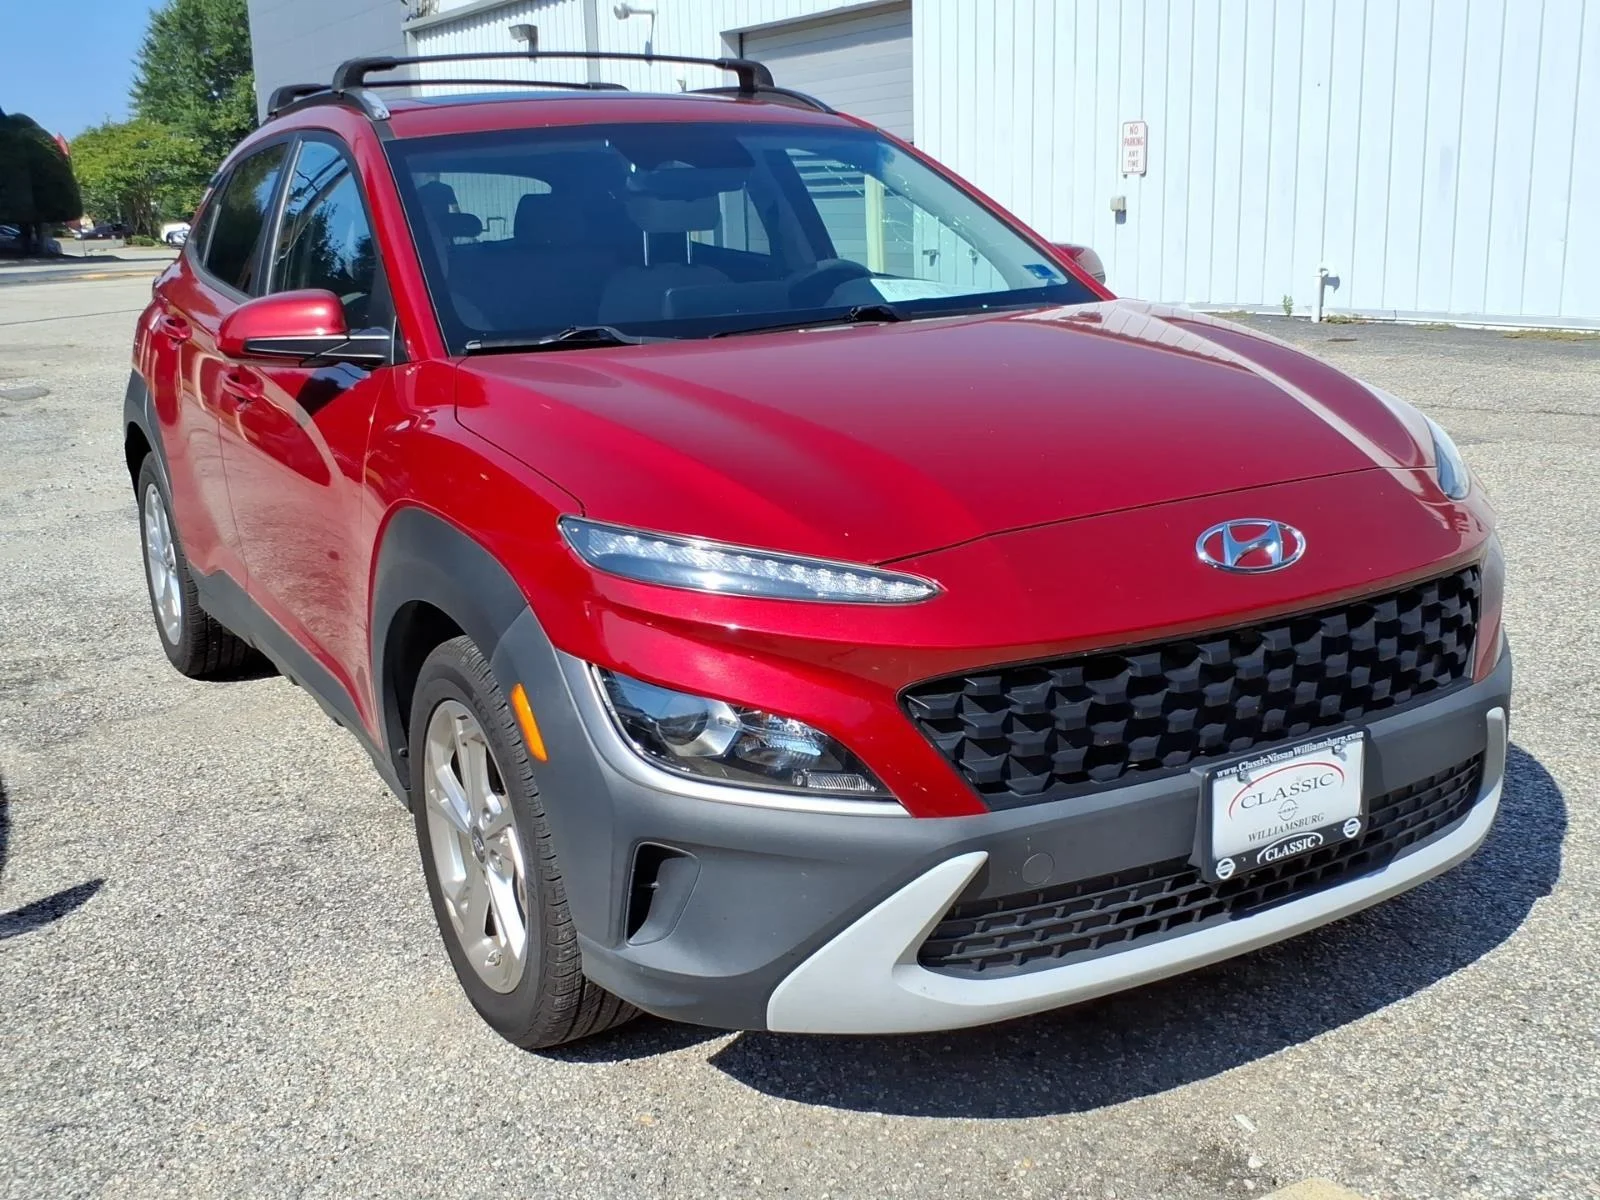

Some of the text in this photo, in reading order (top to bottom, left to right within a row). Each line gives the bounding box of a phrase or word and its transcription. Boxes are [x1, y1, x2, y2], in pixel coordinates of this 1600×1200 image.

[1129, 125, 1139, 136] NO
[1240, 773, 1335, 809] CLASSIC
[1248, 813, 1325, 842] WILLIAMSBURG
[1265, 836, 1317, 862] CLASSIC
